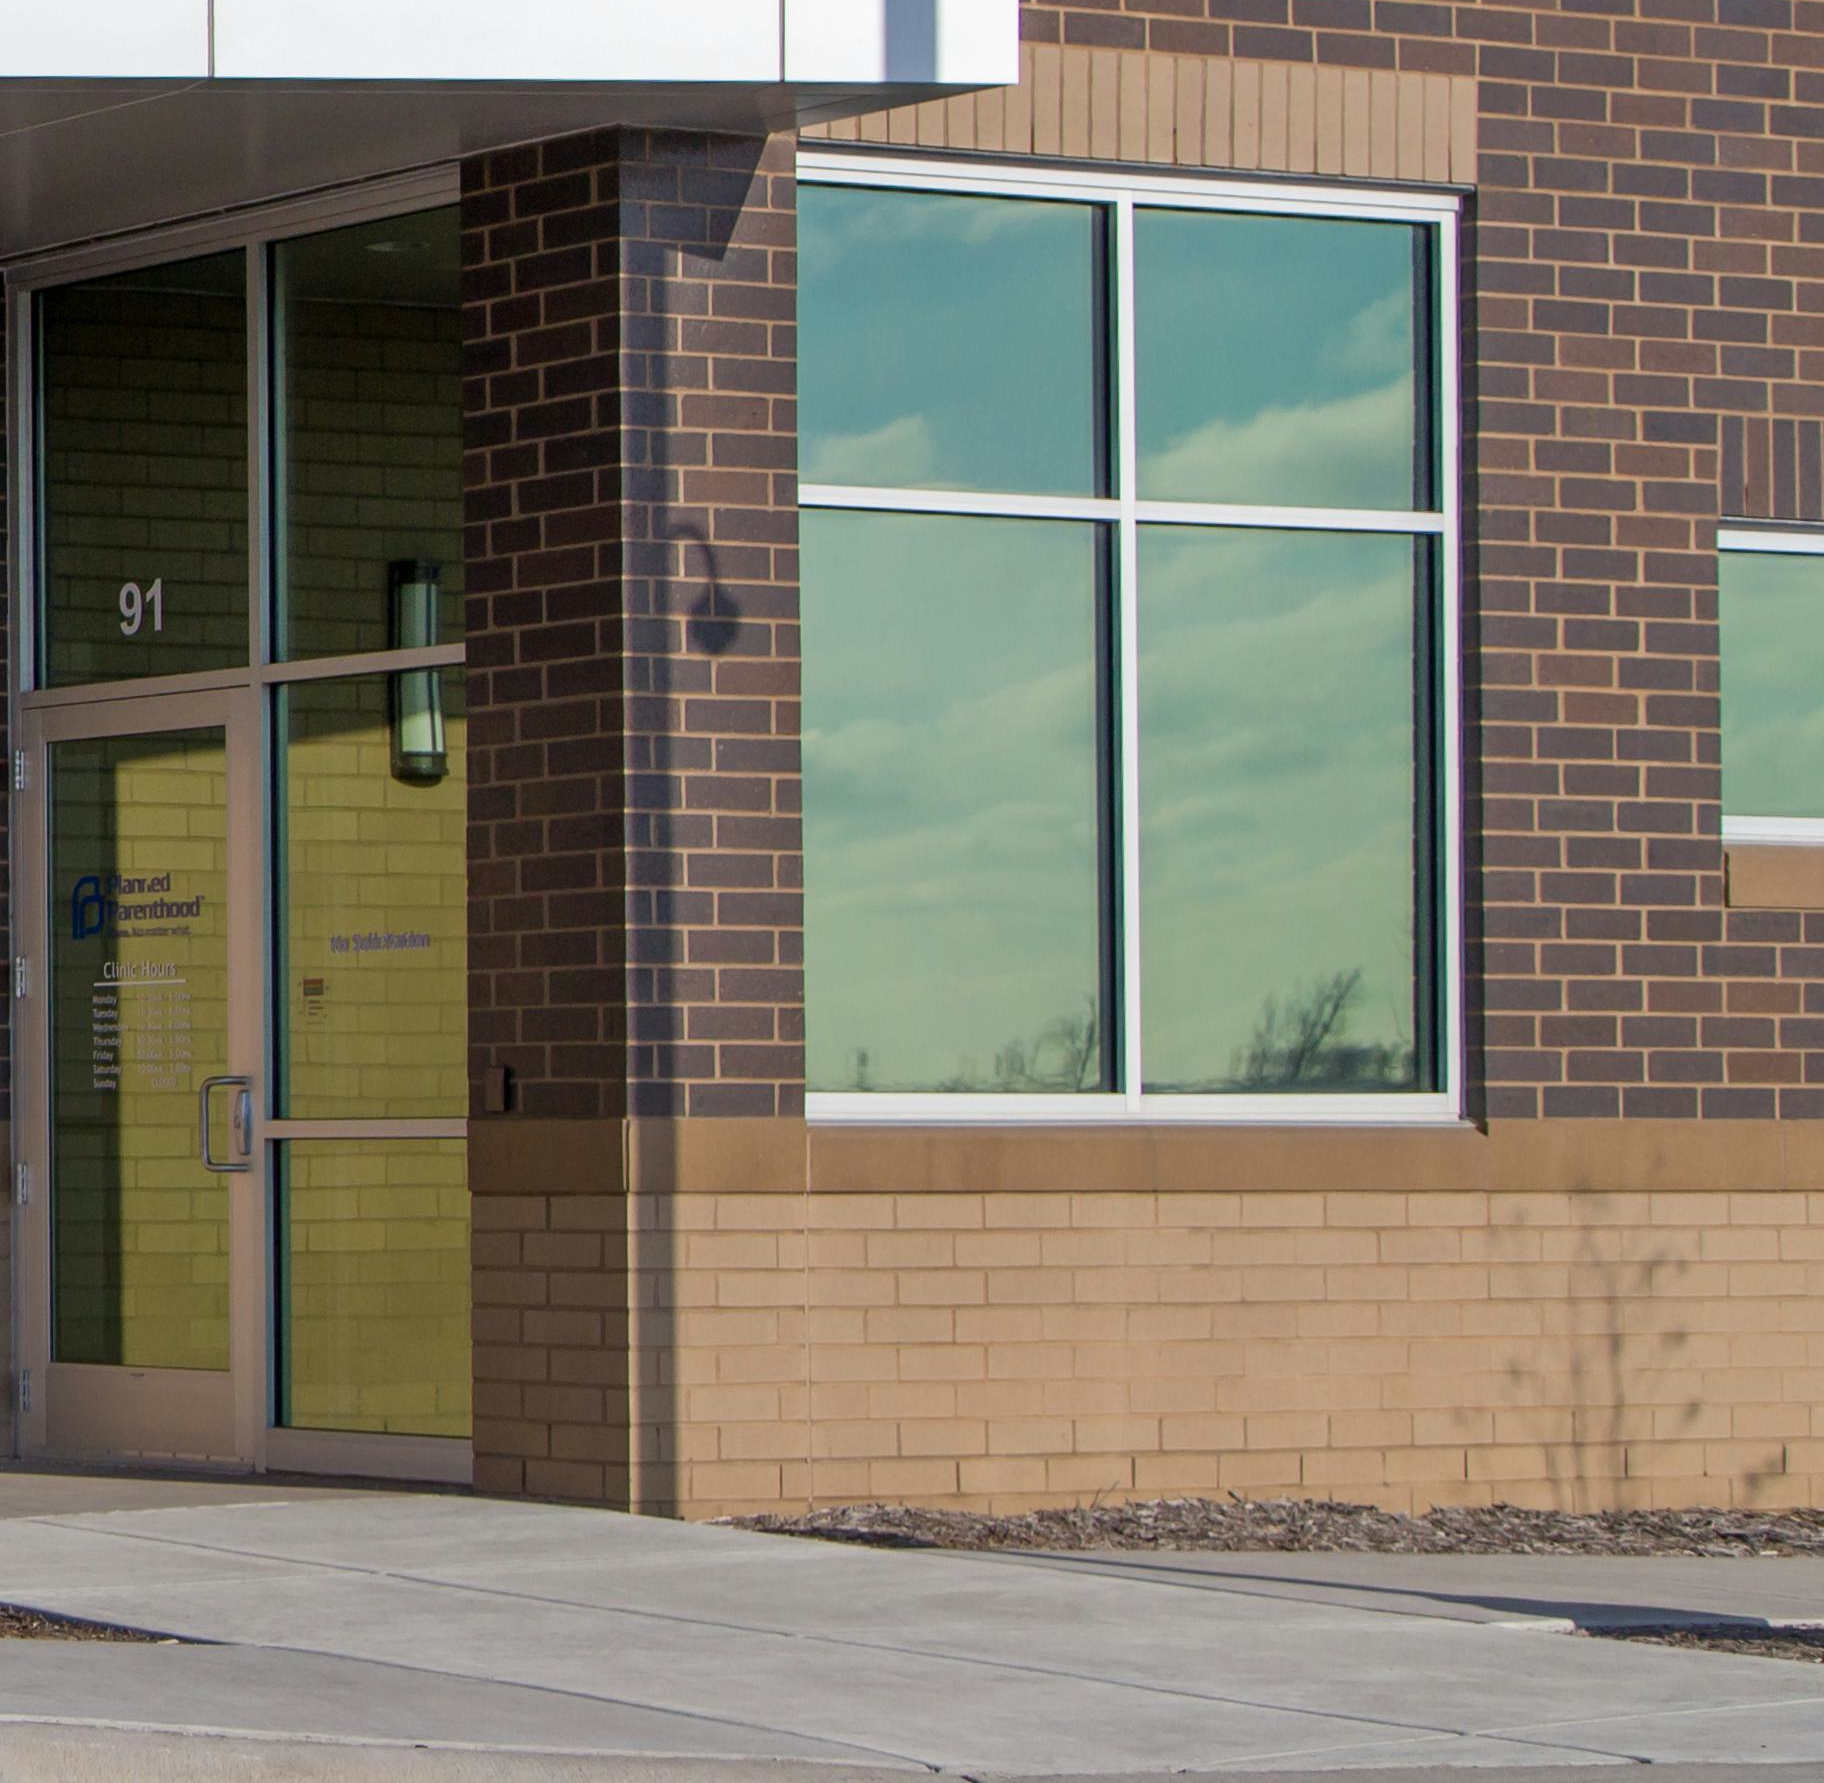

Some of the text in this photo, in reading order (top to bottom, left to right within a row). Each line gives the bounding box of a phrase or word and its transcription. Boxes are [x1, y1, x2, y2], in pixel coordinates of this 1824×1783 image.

[119, 577, 162, 636] 91
[107, 872, 171, 895] Planned
[107, 896, 200, 921] Parenthood
[103, 960, 177, 979] Clinic Hours
[93, 1050, 113, 1062] Friday
